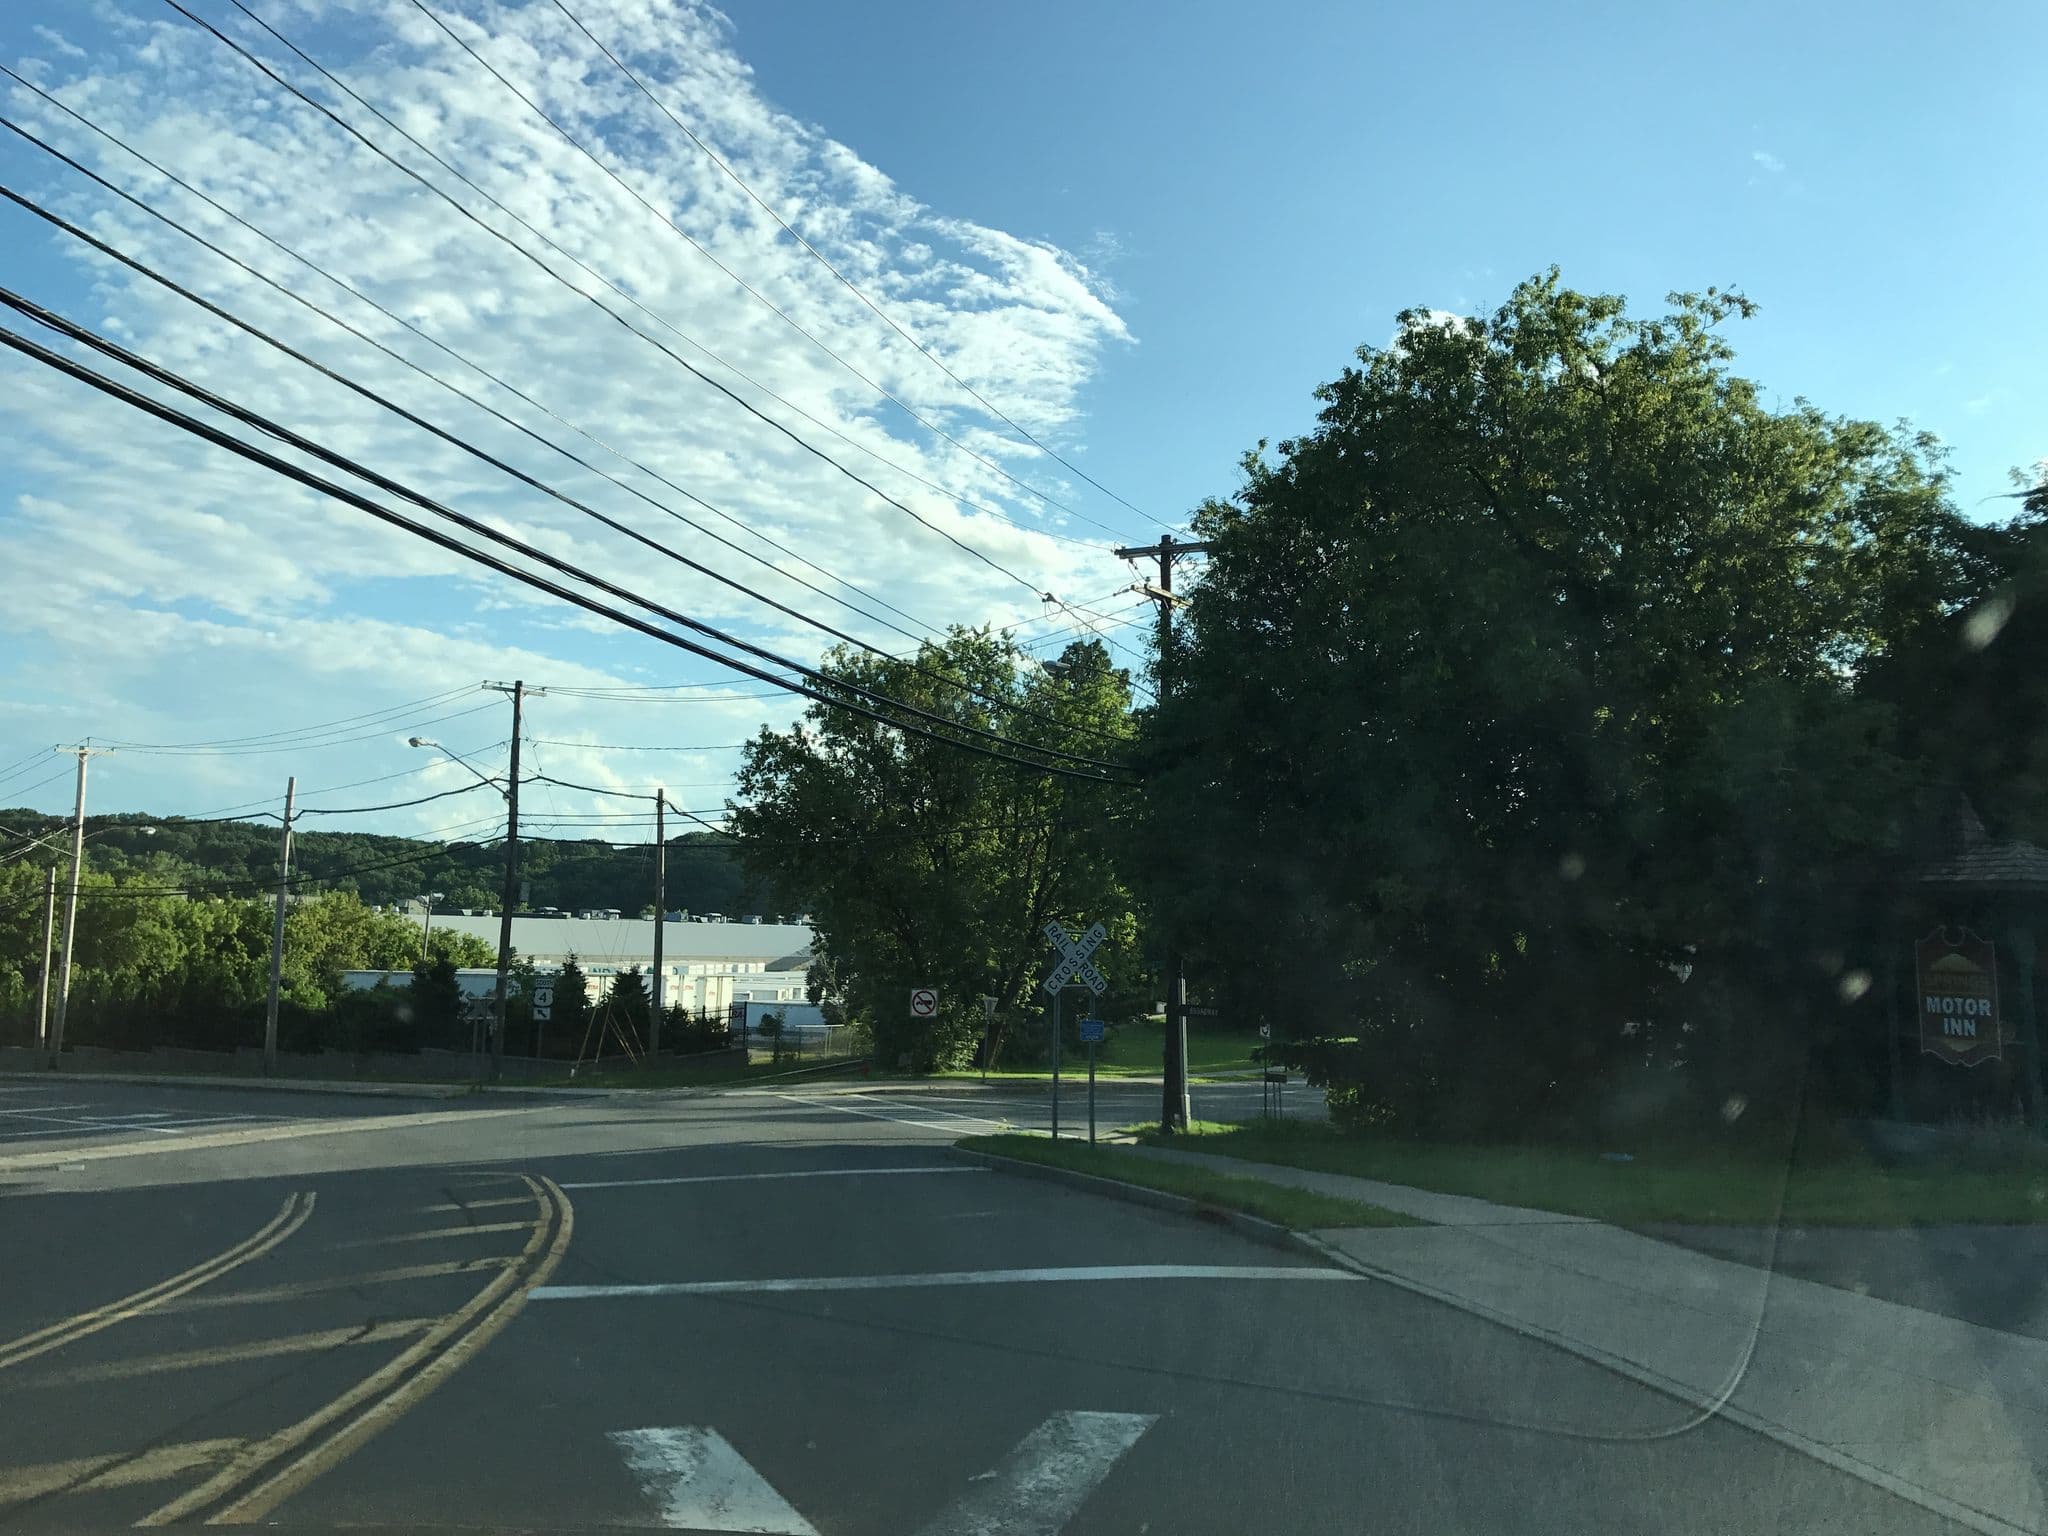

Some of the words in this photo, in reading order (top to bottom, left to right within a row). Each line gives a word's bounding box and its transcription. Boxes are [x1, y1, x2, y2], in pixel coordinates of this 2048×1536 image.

[1048, 925, 1070, 952] RAIL
[1048, 929, 1103, 990] CROSSING
[1079, 962, 1104, 992] ROAD
[538, 991, 547, 1003] 4
[1926, 996, 1992, 1016] MOTOR
[1943, 1018, 1976, 1036] INN
